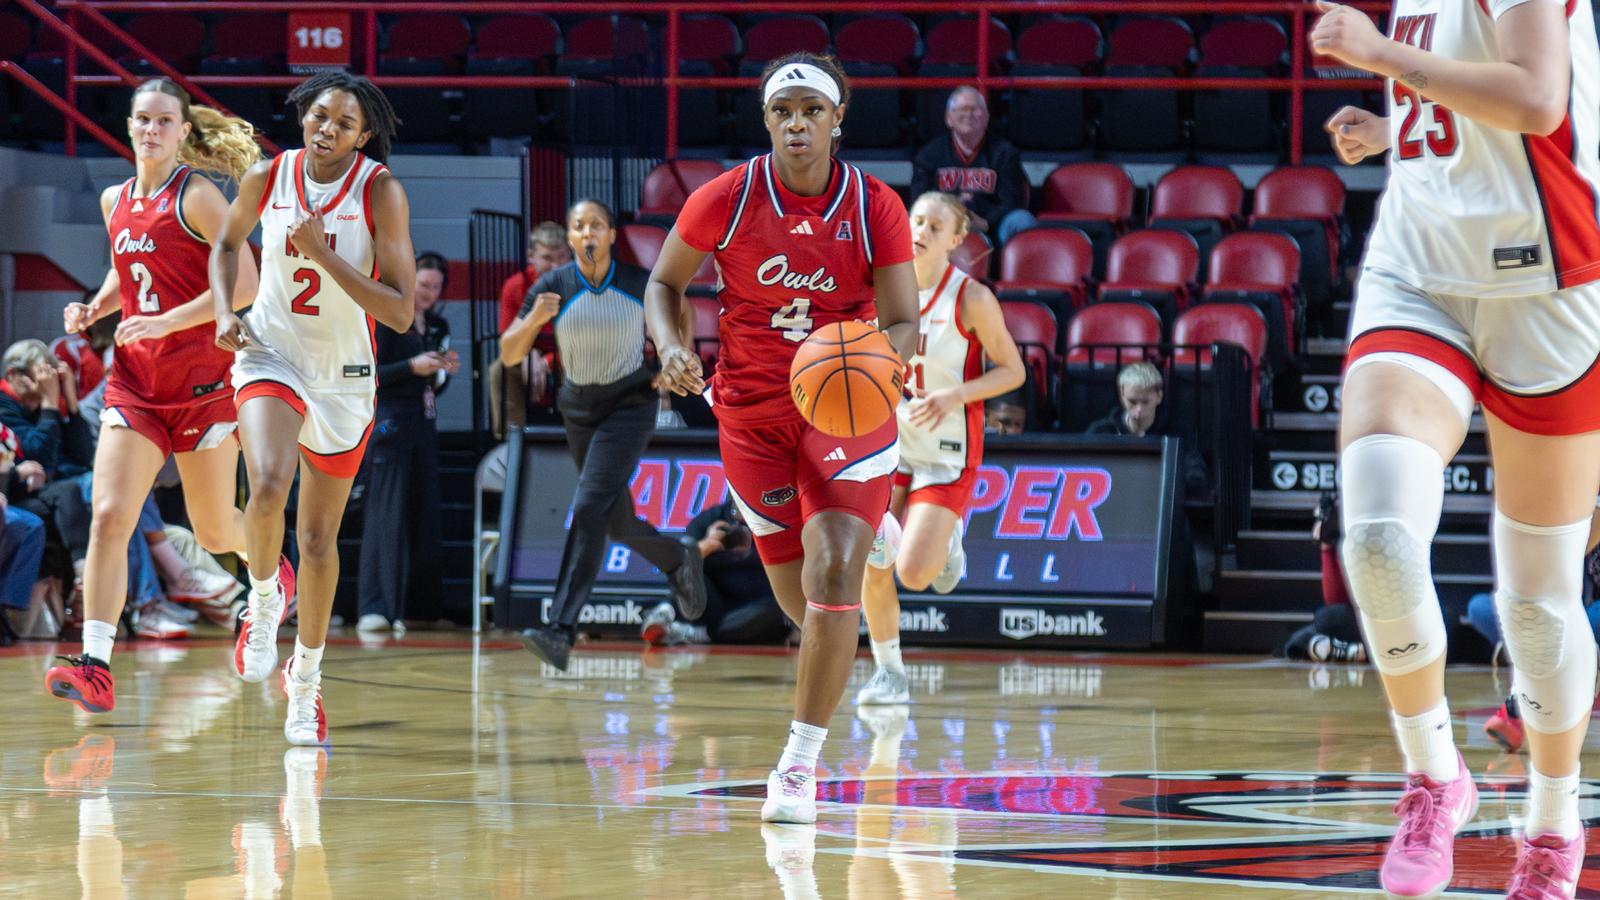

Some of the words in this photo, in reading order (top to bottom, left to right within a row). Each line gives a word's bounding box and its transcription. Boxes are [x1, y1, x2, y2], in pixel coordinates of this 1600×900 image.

[295, 26, 343, 49] 116
[1393, 80, 1460, 160] 23
[936, 167, 997, 193] WKU
[114, 227, 157, 255] Owls
[128, 261, 161, 314] 2
[291, 267, 322, 316] 2
[757, 253, 838, 292] Owls
[770, 297, 814, 343] 4
[1302, 462, 1342, 490] SE
